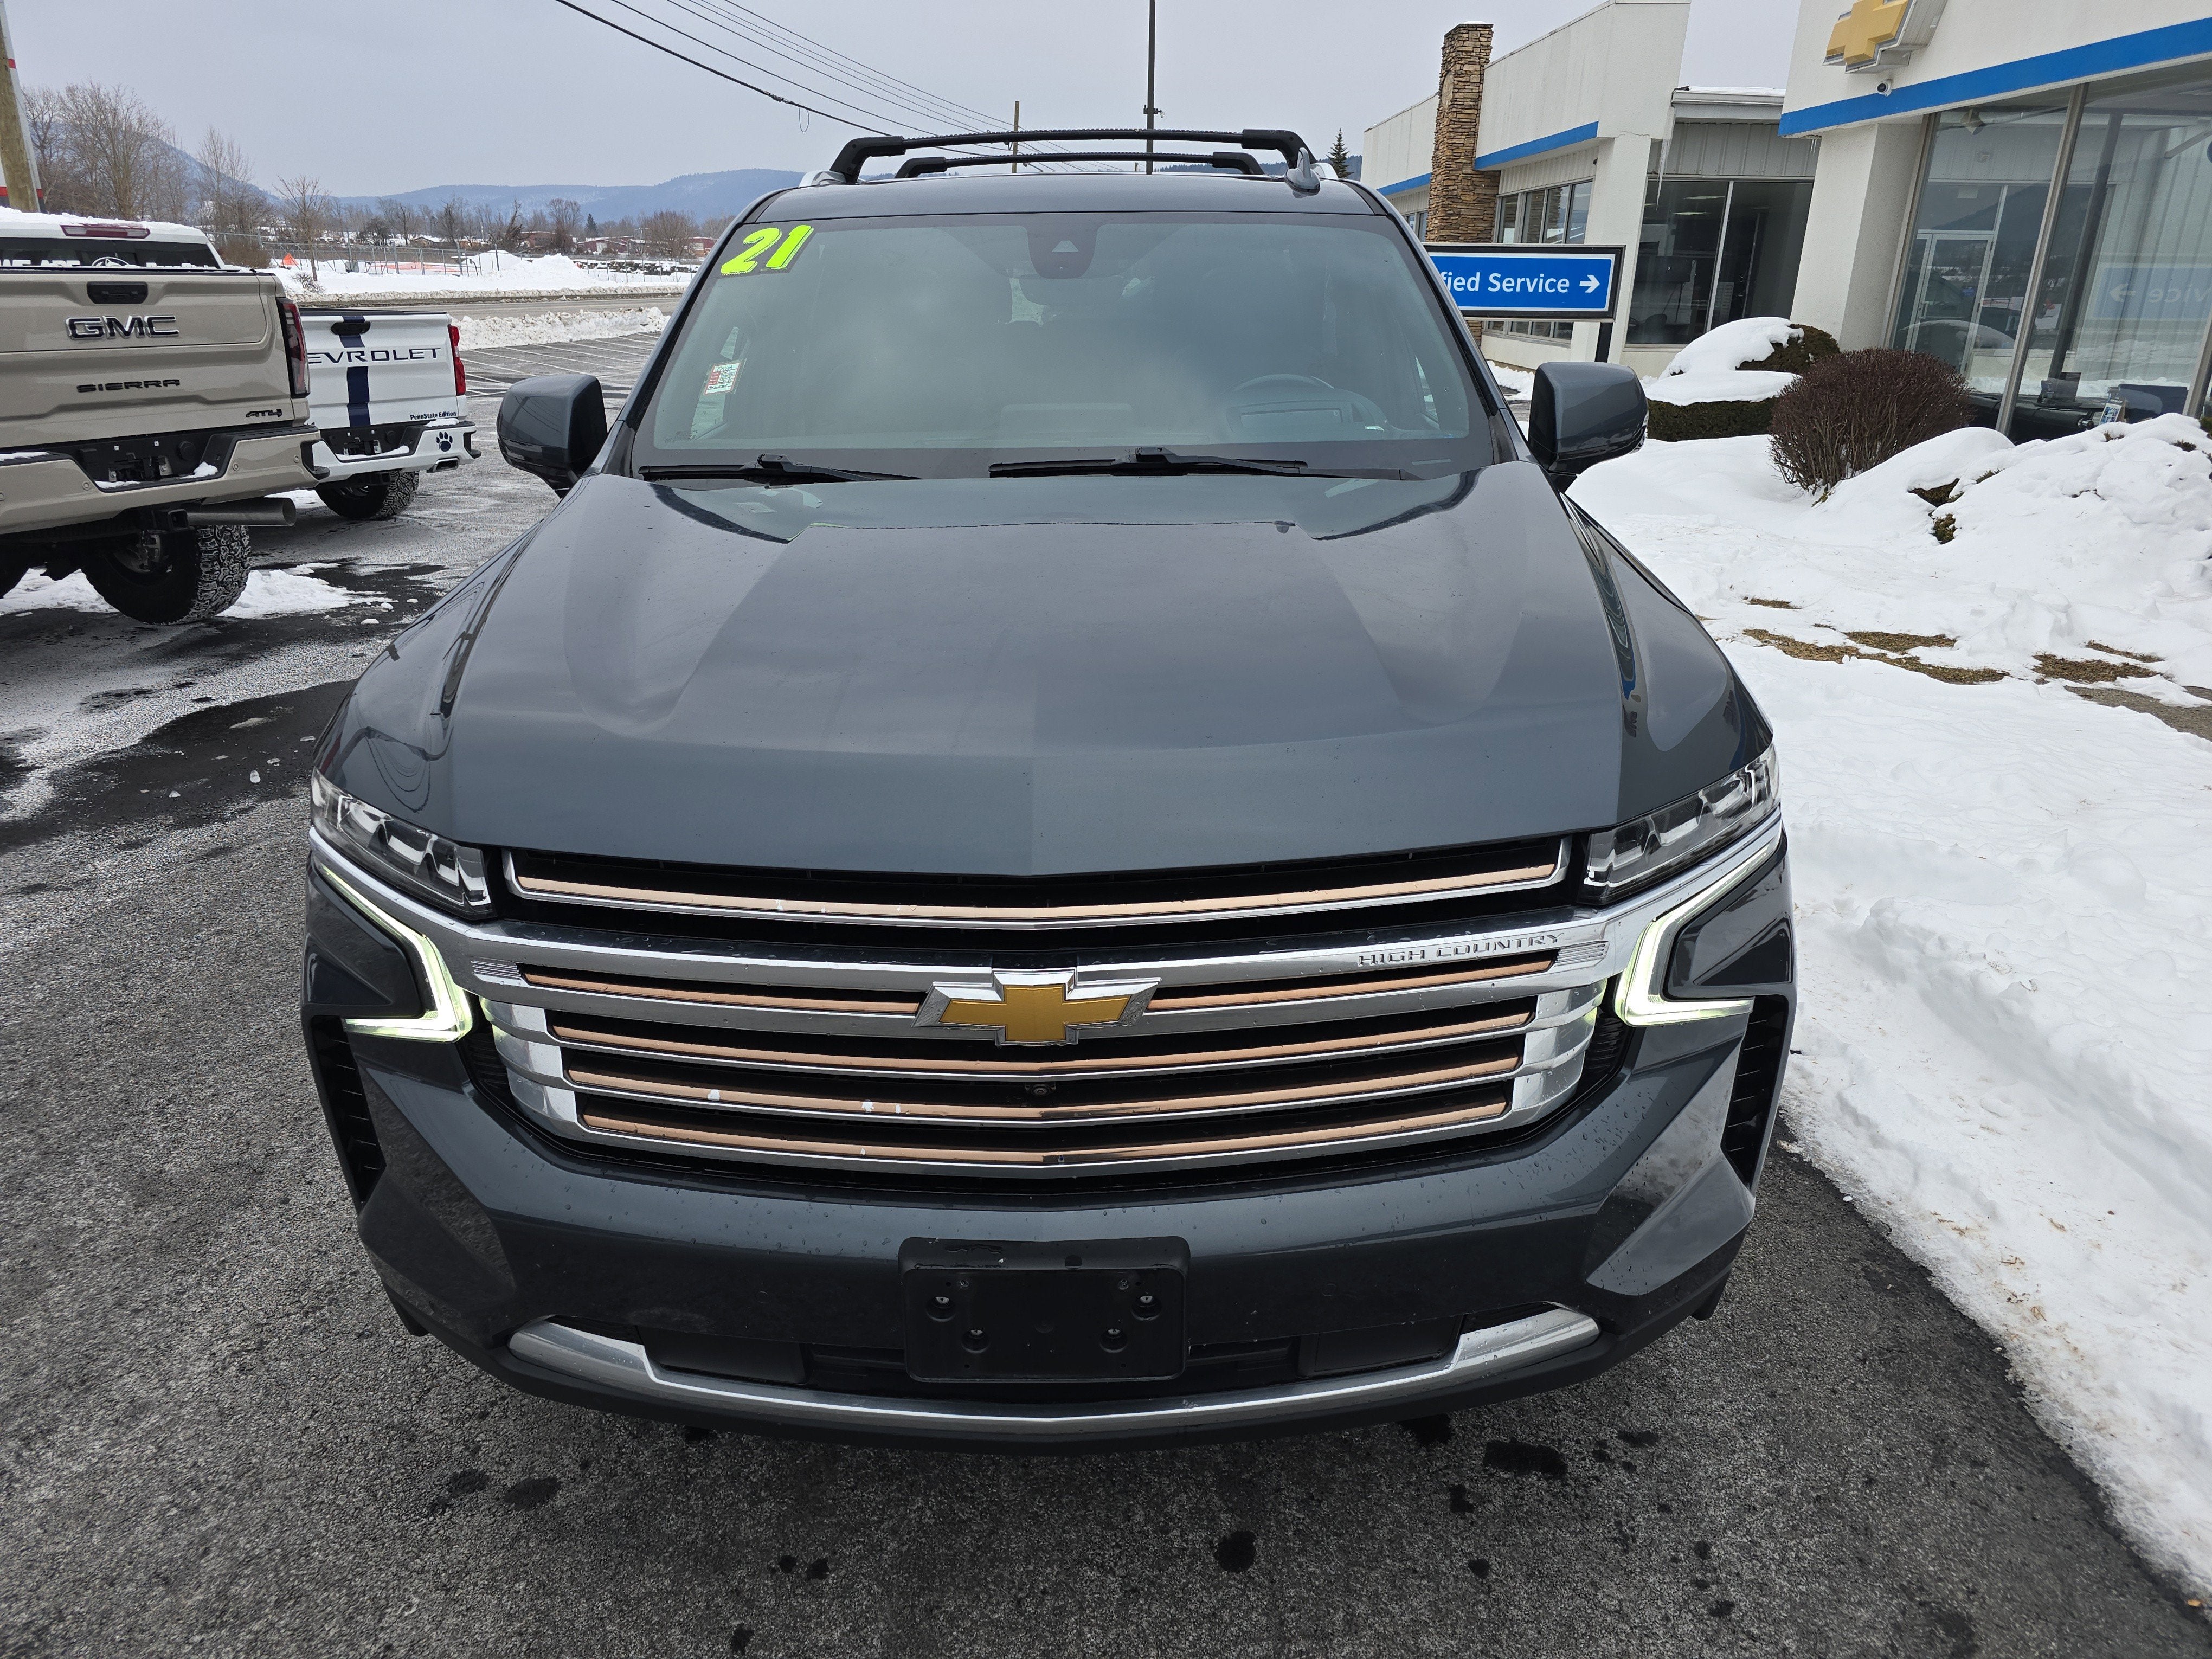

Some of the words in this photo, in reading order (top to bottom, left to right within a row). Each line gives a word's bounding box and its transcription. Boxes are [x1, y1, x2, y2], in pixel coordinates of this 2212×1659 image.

[721, 225, 814, 275] 21
[1440, 271, 1481, 292] fied
[1488, 273, 1570, 293] Service
[66, 314, 179, 340] GMC
[307, 348, 441, 364] EVROLET
[76, 379, 180, 393] SIERRA
[246, 409, 282, 417] AT4
[1358, 949, 1425, 967] HIGH
[1436, 933, 1565, 957] COUNTRY
